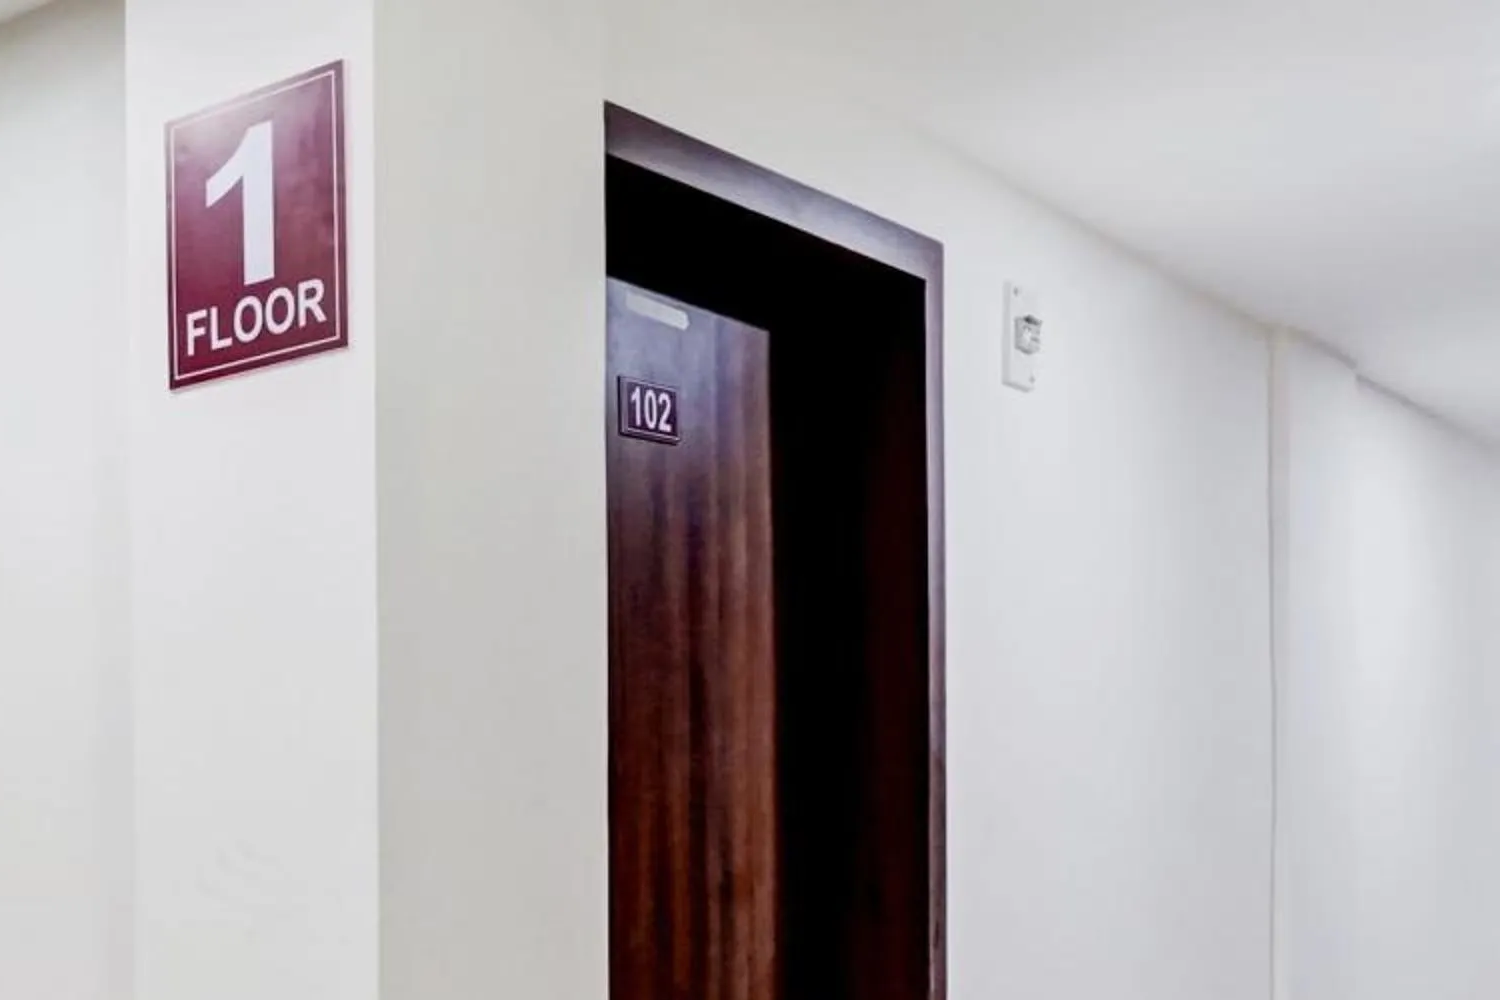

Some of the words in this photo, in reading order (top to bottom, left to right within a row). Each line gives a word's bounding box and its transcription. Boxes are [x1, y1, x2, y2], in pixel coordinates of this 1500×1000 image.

[205, 118, 275, 286] 1
[185, 278, 327, 356] FLOOR
[630, 386, 672, 432] 102
